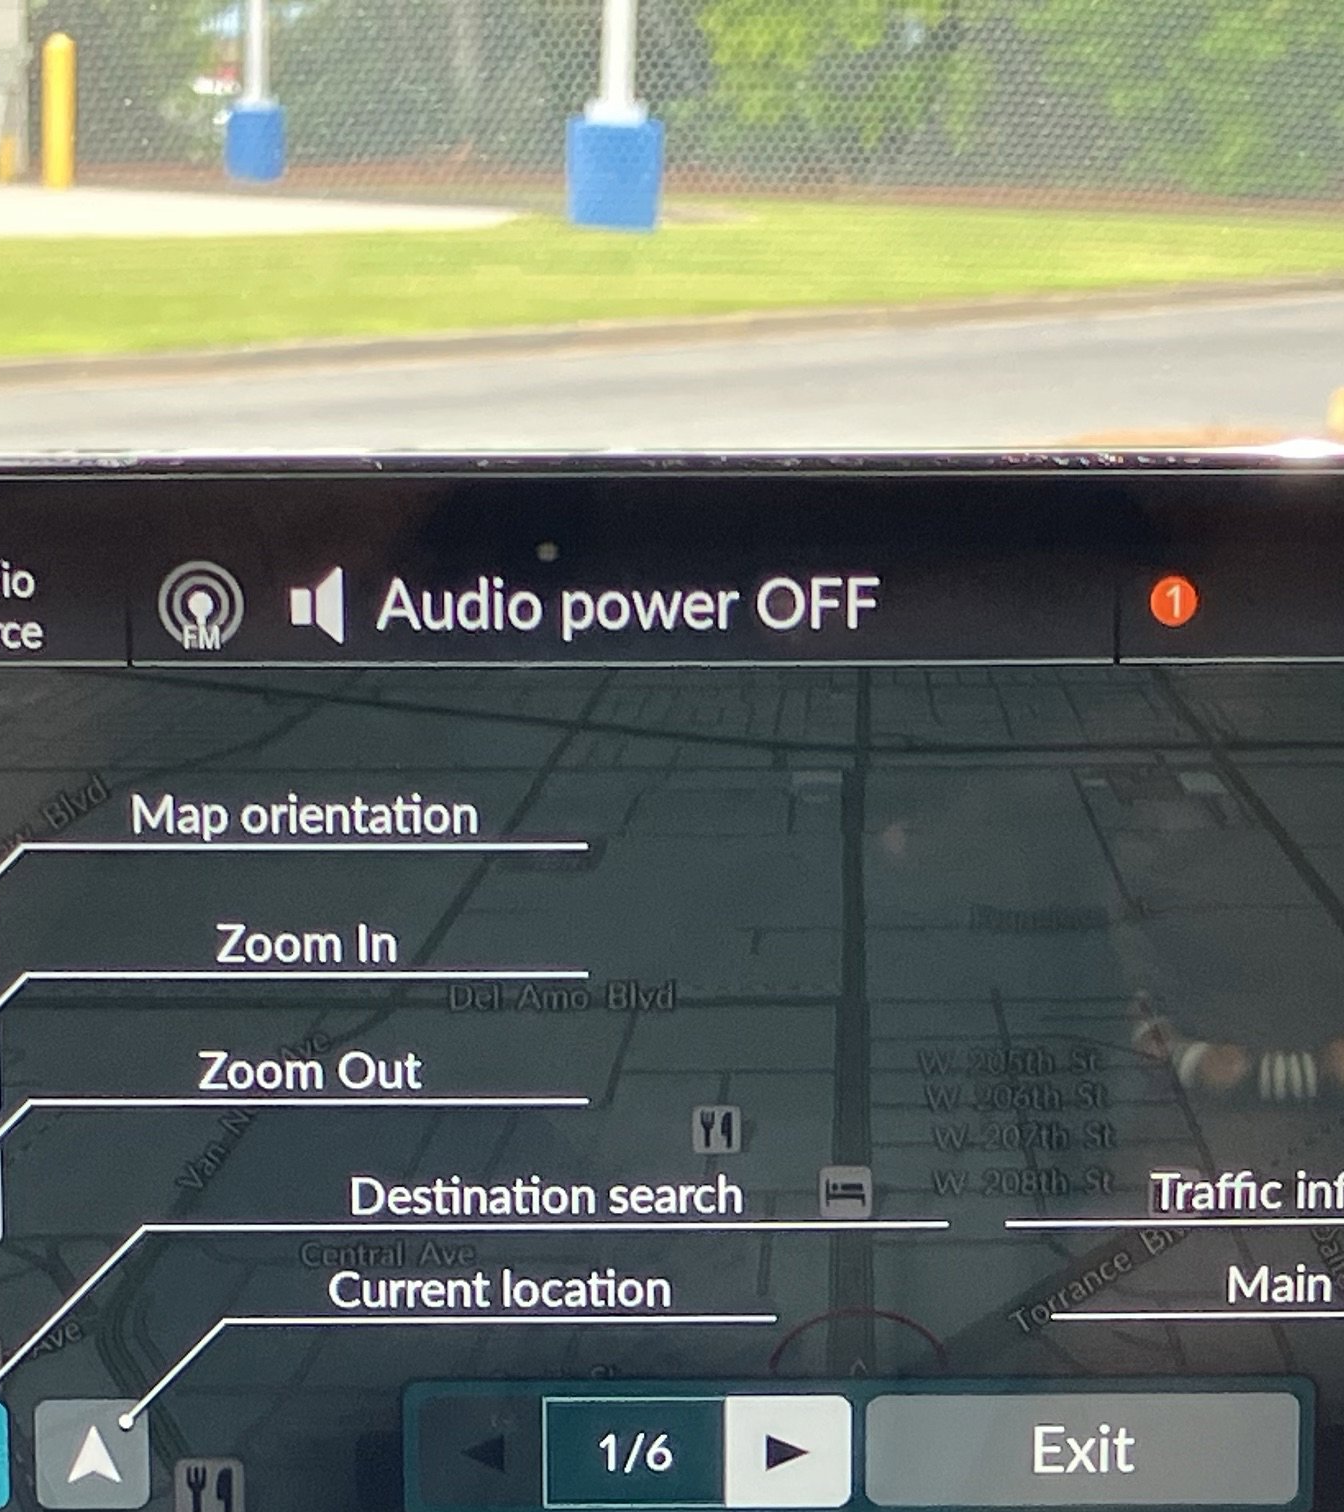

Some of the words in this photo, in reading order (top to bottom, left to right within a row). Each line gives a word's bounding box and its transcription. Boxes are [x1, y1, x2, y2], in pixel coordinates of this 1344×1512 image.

[376, 575, 543, 631] Audio
[561, 590, 740, 641] power
[757, 577, 880, 630] OFF
[183, 624, 221, 650] FM
[43, 774, 110, 831] Blvd
[131, 793, 229, 841] Map
[239, 791, 478, 836] orientation
[215, 922, 342, 963] Zoom
[357, 922, 398, 963] In
[449, 982, 502, 1010] Del
[516, 983, 590, 1010] Amo
[606, 980, 677, 1011] Blvd
[198, 1050, 324, 1091] Zoom
[337, 1050, 423, 1091] Out
[918, 1050, 953, 1076] W
[1068, 1048, 1101, 1074] St
[924, 1084, 960, 1111] W
[1077, 1083, 1108, 1110] St
[933, 1123, 969, 1150] W
[1083, 1123, 1117, 1149] St
[177, 1140, 228, 1191] Van
[932, 1169, 968, 1196] W
[982, 1168, 1068, 1196] 208th
[1082, 1169, 1116, 1195] St
[350, 1174, 596, 1216] Destination
[609, 1172, 744, 1214] search
[1149, 1169, 1283, 1210] Traffic
[300, 1241, 404, 1269] Central
[420, 1240, 477, 1268] Ave
[328, 1269, 492, 1309] Current
[503, 1267, 672, 1309] location
[1008, 1247, 1133, 1335] Torrance
[1227, 1262, 1333, 1304] Main
[599, 1432, 674, 1475] 1/6
[1034, 1423, 1136, 1474] Exit
